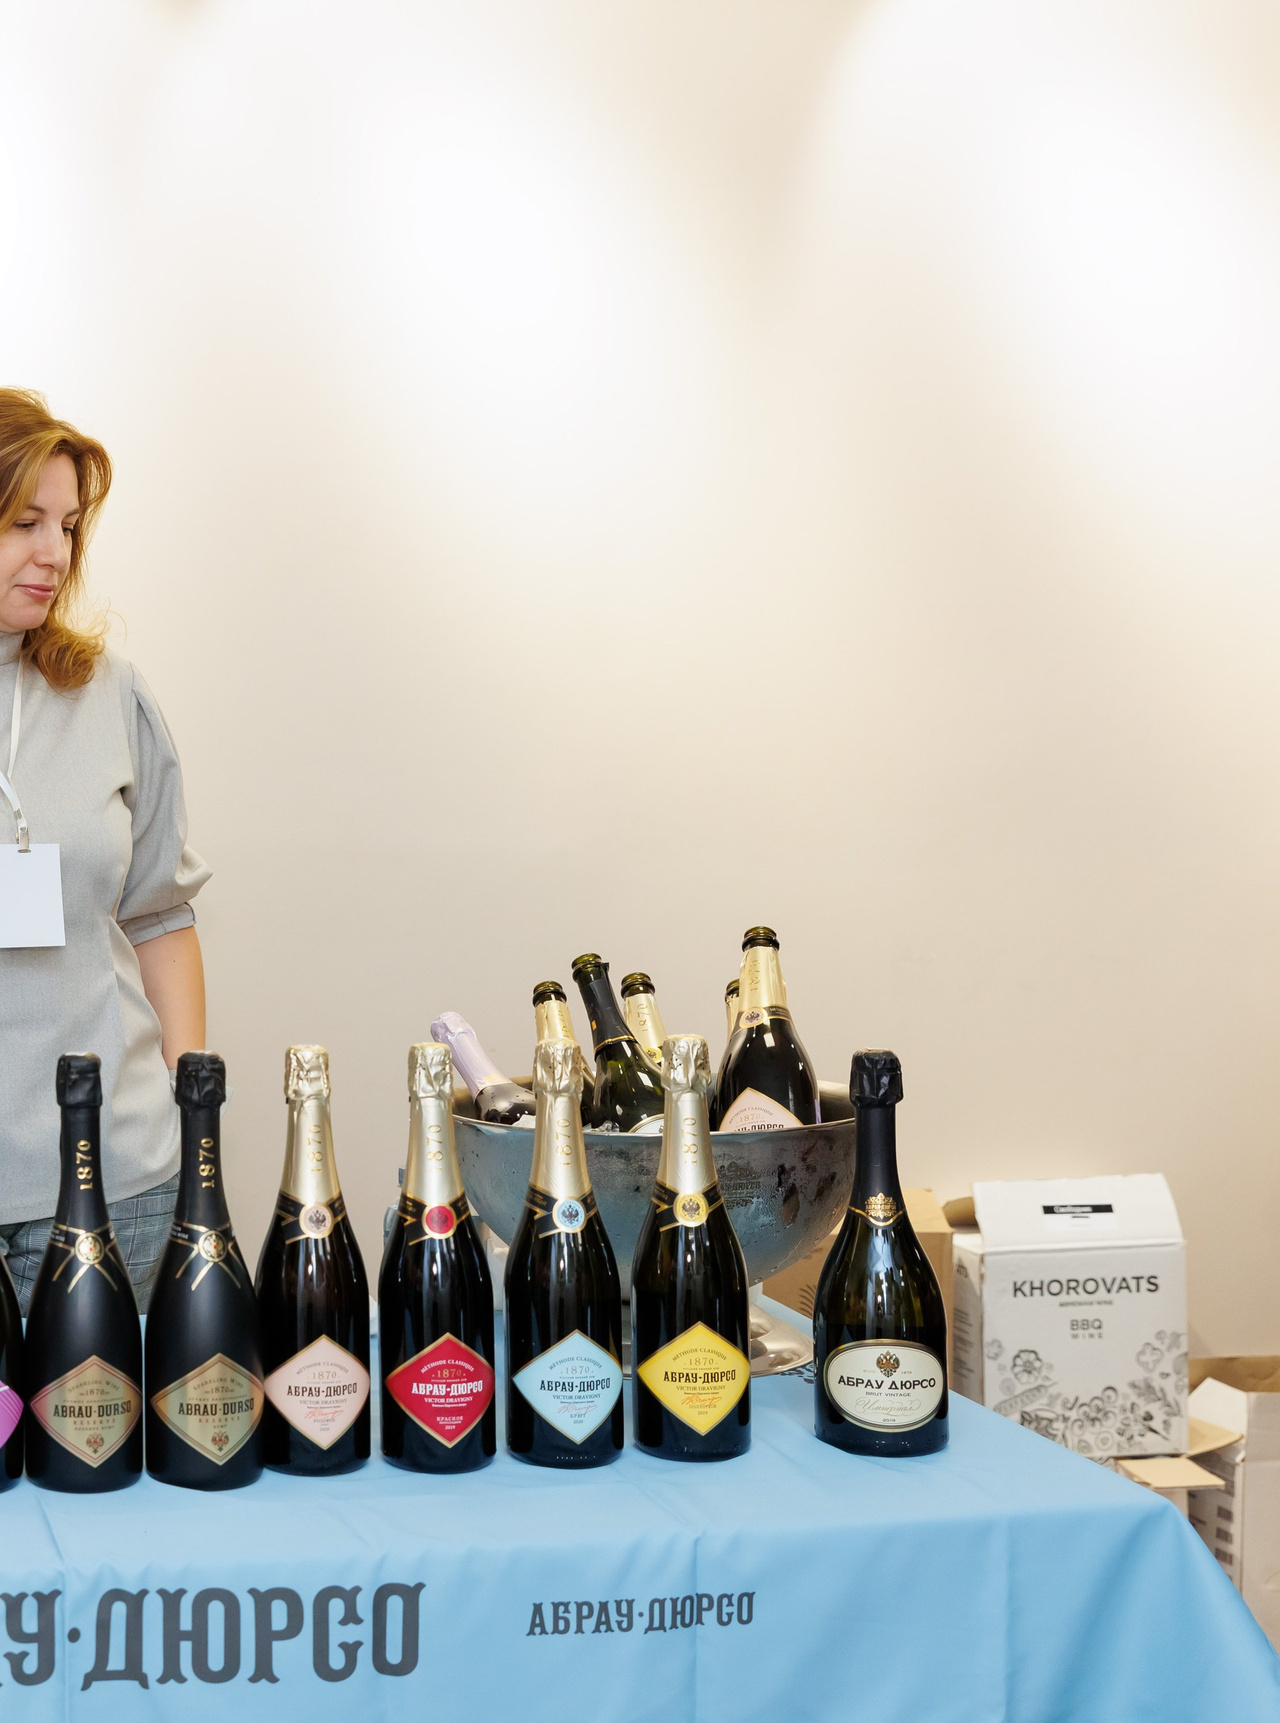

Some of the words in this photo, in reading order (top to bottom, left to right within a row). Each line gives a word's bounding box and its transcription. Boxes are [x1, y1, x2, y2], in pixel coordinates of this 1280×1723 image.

[555, 1118, 572, 1167] 1870
[681, 1117, 699, 1165] 1870
[307, 1124, 323, 1172] 1870
[426, 1124, 444, 1172] 1870
[76, 1139, 93, 1190] 1870
[199, 1137, 216, 1188] 1870
[1012, 1275, 1160, 1298] KHOROVATS
[1071, 1318, 1103, 1330] BBQ
[1070, 1331, 1104, 1340] WINE
[688, 1357, 714, 1366] 1870
[312, 1371, 337, 1380] 1870
[437, 1368, 462, 1379] 1870
[565, 1365, 590, 1375] 1870
[838, 1374, 884, 1389] АБРАУ
[888, 1377, 936, 1390] ДЮРСО
[85, 1388, 105, 1396] 1870
[210, 1386, 230, 1394] 1870
[199, 1416, 240, 1424] RESERVE
